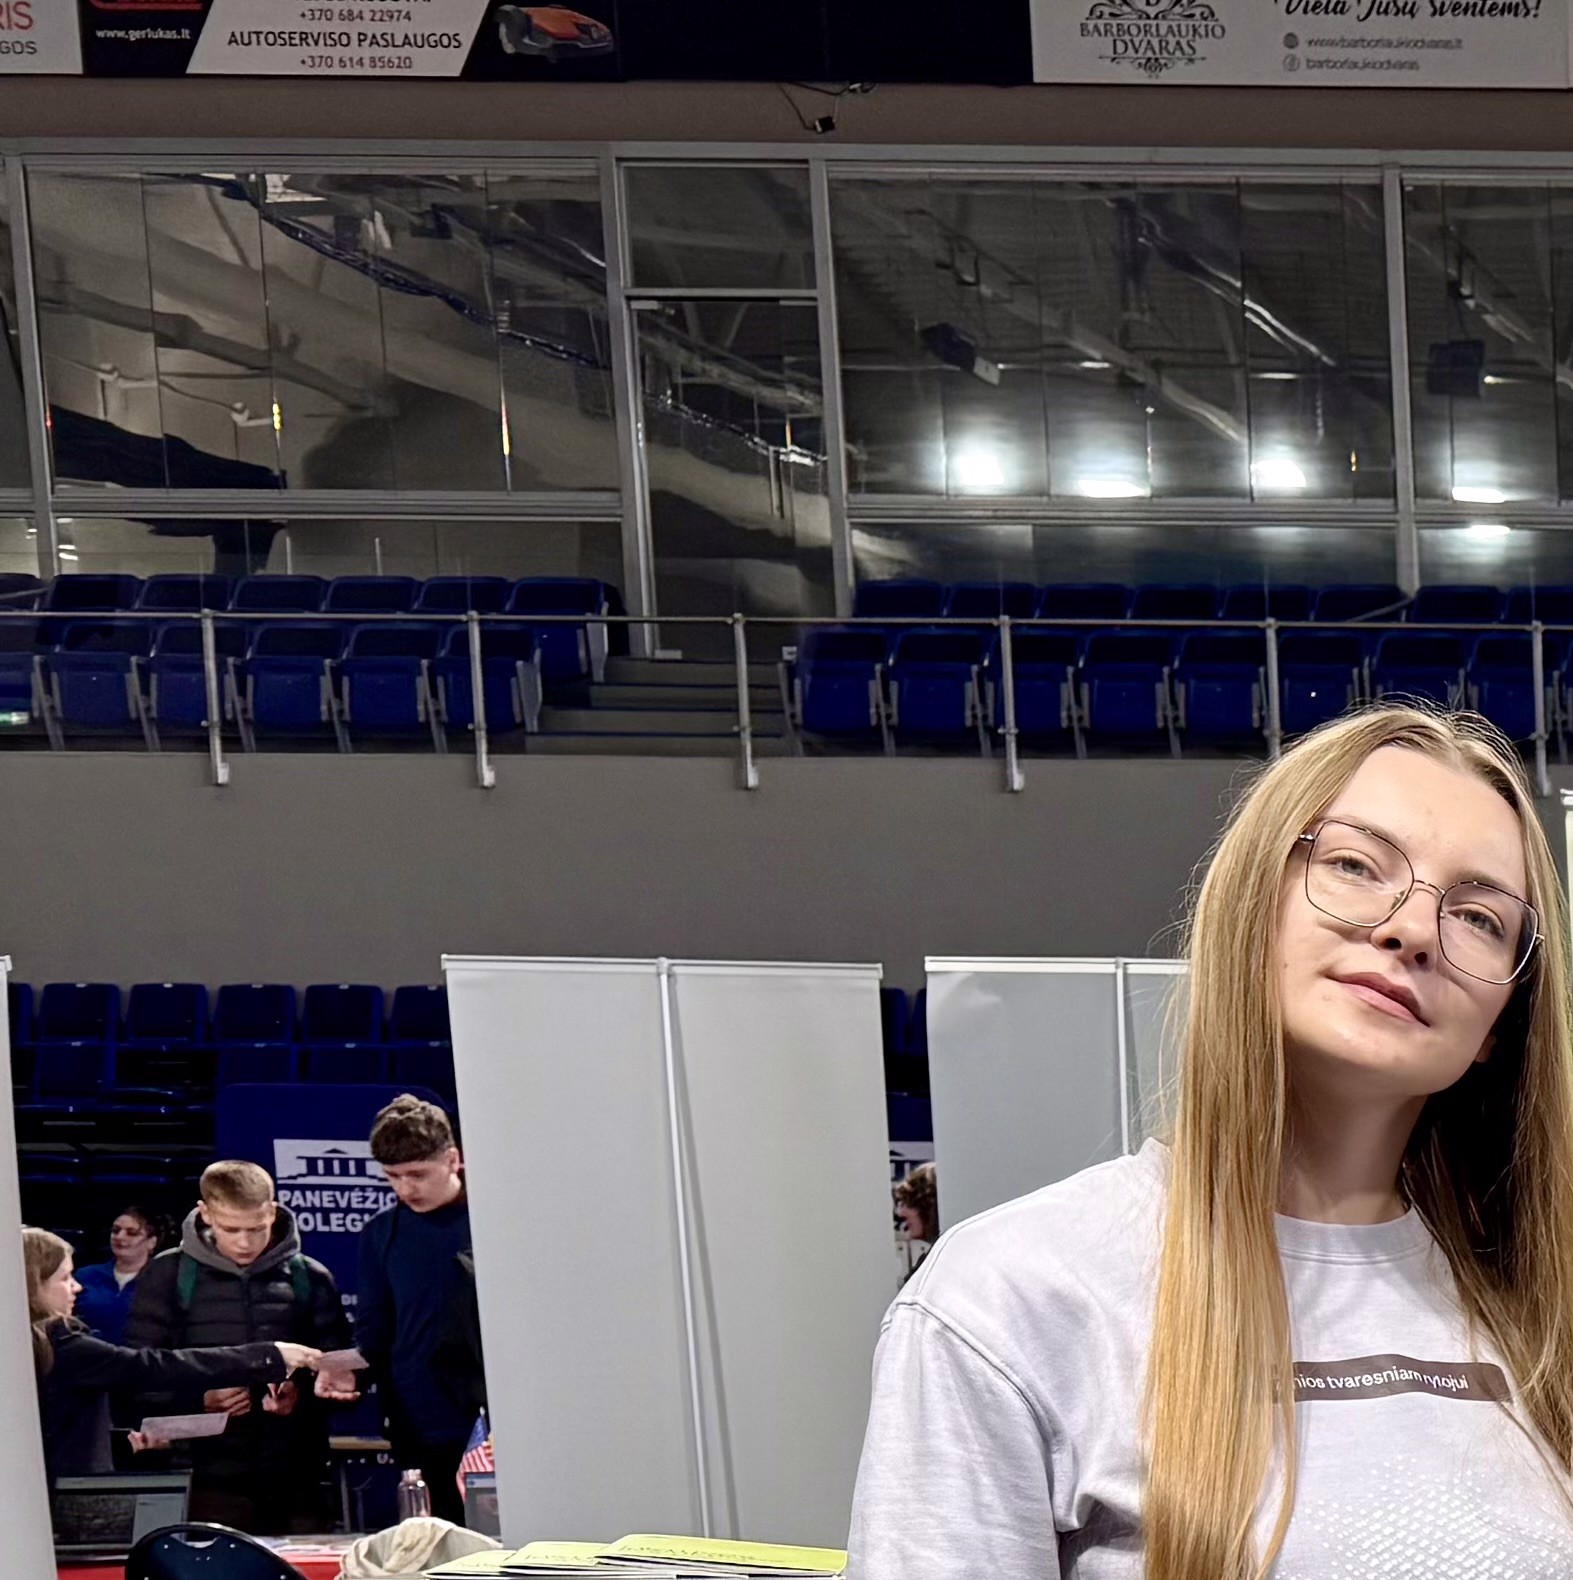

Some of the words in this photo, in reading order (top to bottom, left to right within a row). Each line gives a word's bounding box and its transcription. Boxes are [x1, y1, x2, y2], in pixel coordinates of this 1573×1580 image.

[227, 31, 351, 47] AUTOSERVISO
[357, 32, 462, 48] PASLAUGOS
[1112, 39, 1197, 56] DVARAS
[296, 1212, 369, 1233] OLEG
